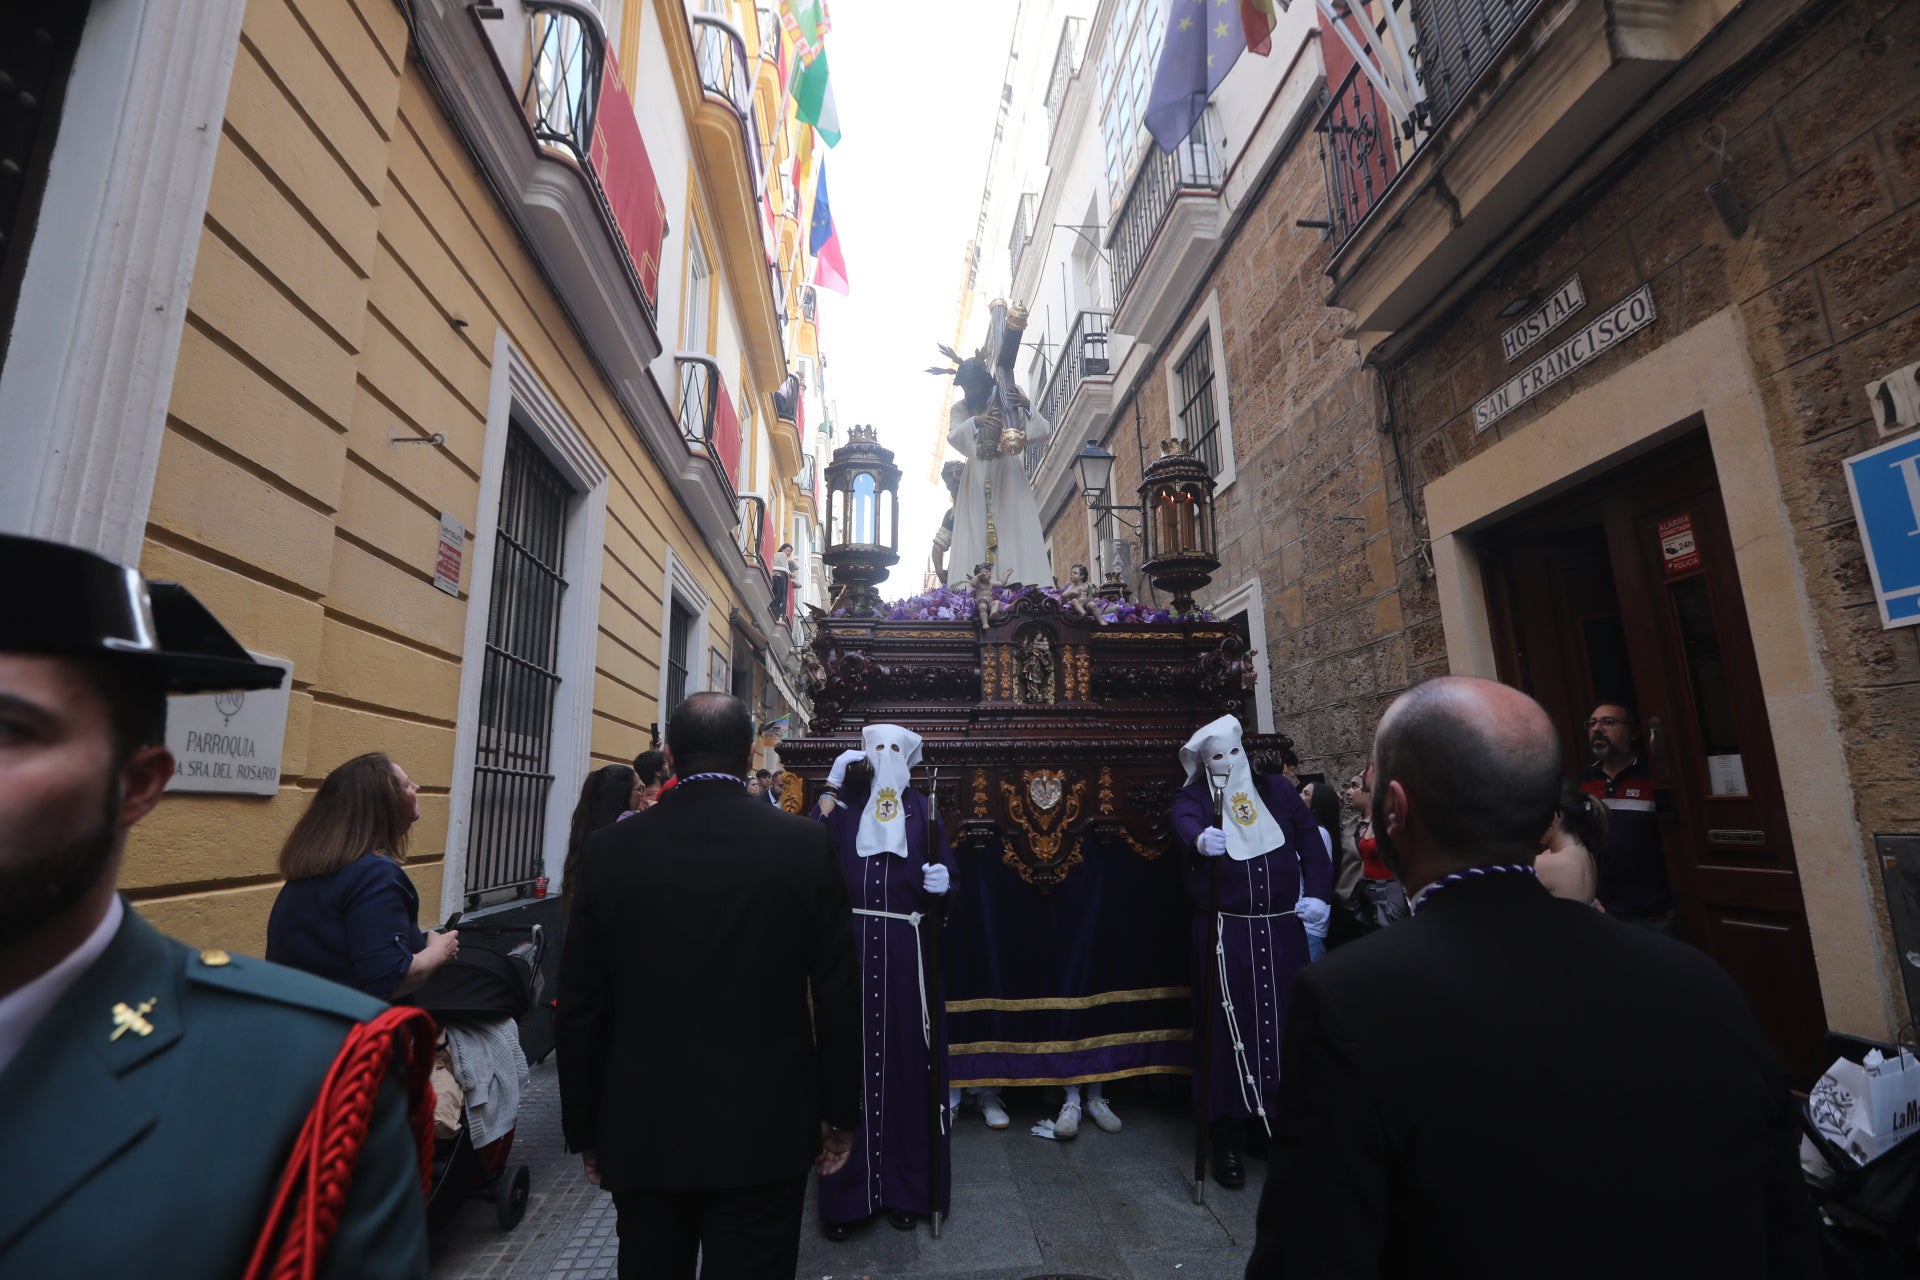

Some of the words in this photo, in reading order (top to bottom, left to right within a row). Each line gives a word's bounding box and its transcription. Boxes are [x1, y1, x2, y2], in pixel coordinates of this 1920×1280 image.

[1503, 288, 1579, 356] HOSTAL
[1478, 390, 1509, 424] SAN
[1521, 298, 1646, 397] FRANCISCO
[1660, 515, 1689, 531] ALARMA
[186, 731, 255, 758] PARROQUIA
[187, 760, 209, 778] SRA
[213, 762, 232, 779] DEL
[237, 764, 277, 781] ROSARIO
[1893, 1099, 1920, 1132] LaM
